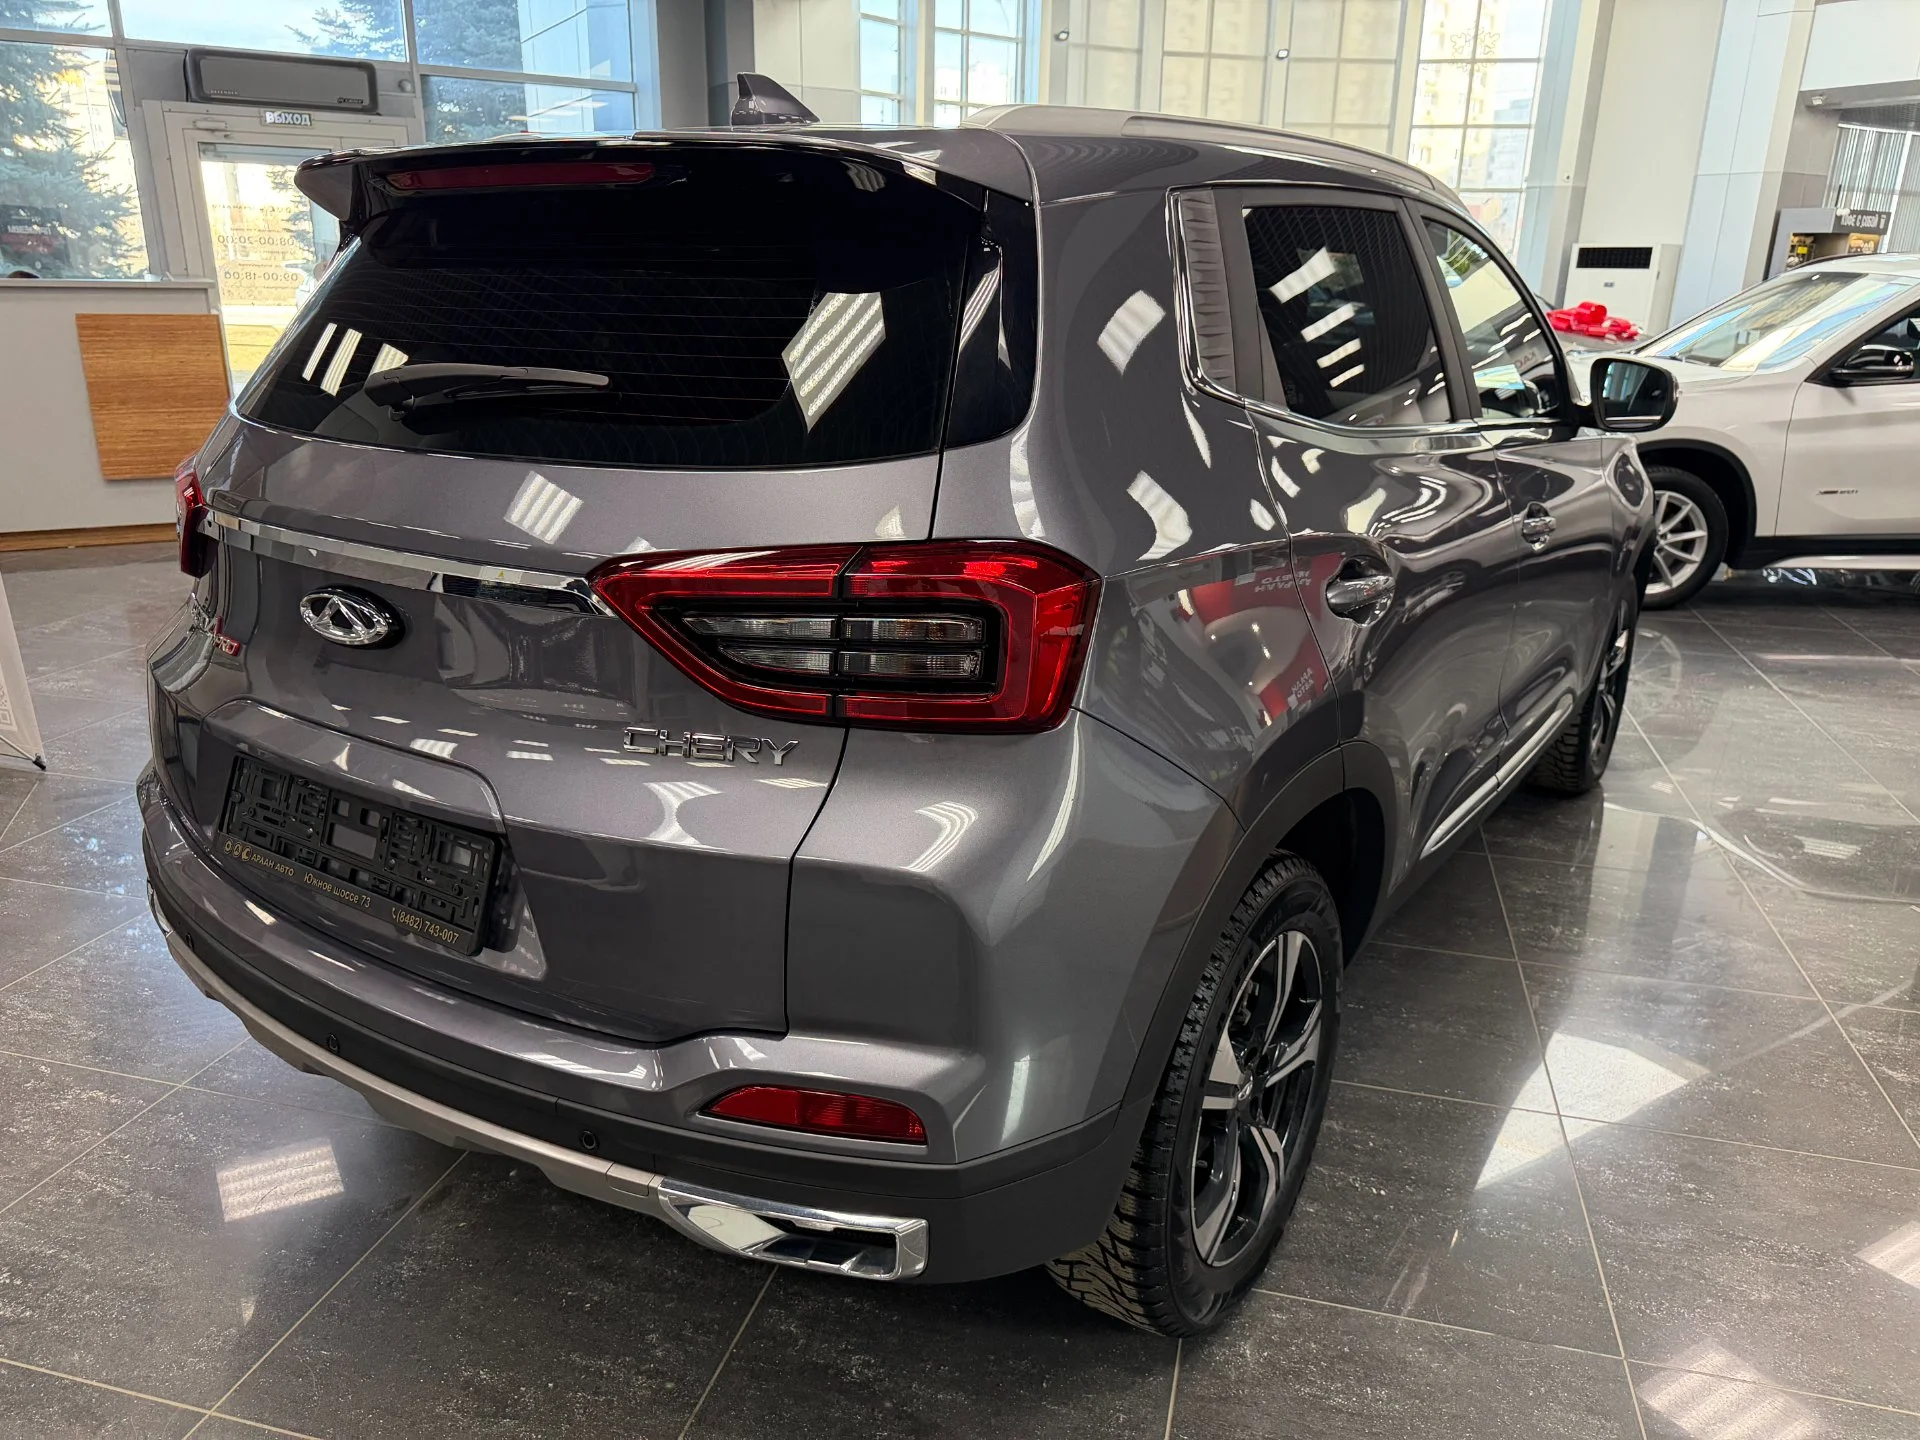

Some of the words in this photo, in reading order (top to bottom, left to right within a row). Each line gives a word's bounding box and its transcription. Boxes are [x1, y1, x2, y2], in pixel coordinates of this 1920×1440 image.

[265, 111, 312, 126] ВЫХОД
[212, 634, 238, 655] PRO
[623, 726, 800, 766] CHERY
[250, 853, 275, 870] АРЛАН
[275, 862, 295, 877] АВТО
[303, 871, 333, 893] Южное
[333, 882, 360, 905] шоссе
[360, 894, 372, 909] 73
[396, 909, 424, 933] (8482)
[424, 919, 460, 945] 743-007
